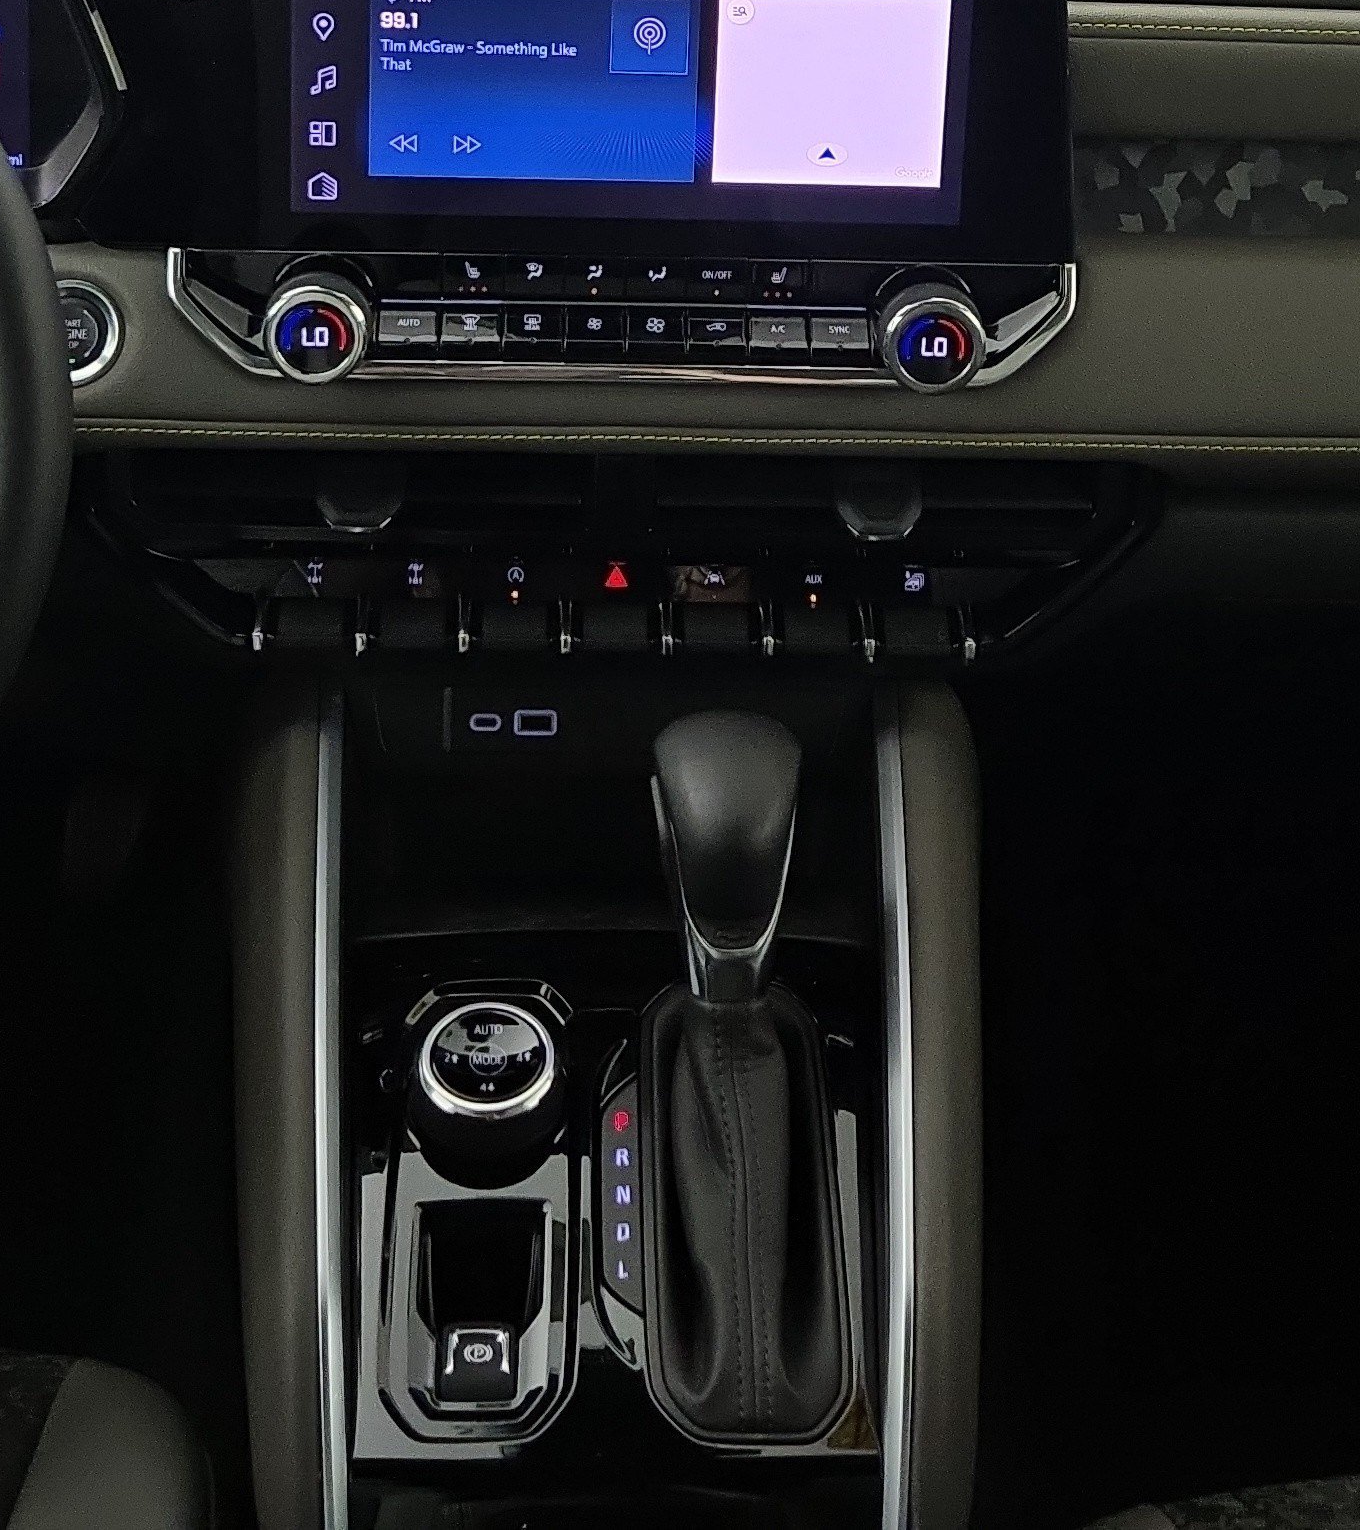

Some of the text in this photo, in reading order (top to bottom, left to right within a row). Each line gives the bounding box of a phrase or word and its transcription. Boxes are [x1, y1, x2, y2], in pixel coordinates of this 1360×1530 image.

[380, 11, 419, 29] 99.1
[379, 38, 407, 53] Tim
[408, 39, 465, 54] McGraw
[476, 40, 548, 58] Something
[551, 42, 578, 57] Like
[380, 56, 412, 71] That
[701, 270, 733, 280] ON/OFF
[65, 319, 82, 328] ART
[396, 318, 421, 327] AUTO
[770, 324, 786, 334] A/C
[828, 325, 851, 335] SYNC
[67, 329, 88, 341] GINE
[300, 326, 329, 347] LO
[921, 337, 948, 358] LO
[805, 574, 823, 585] AUX
[473, 1023, 504, 1035] AUTO
[472, 1055, 504, 1066] MODE
[614, 1111, 629, 1132] P
[615, 1147, 630, 1167] R
[616, 1184, 631, 1205] N
[616, 1222, 630, 1242] D
[617, 1259, 629, 1280] L
